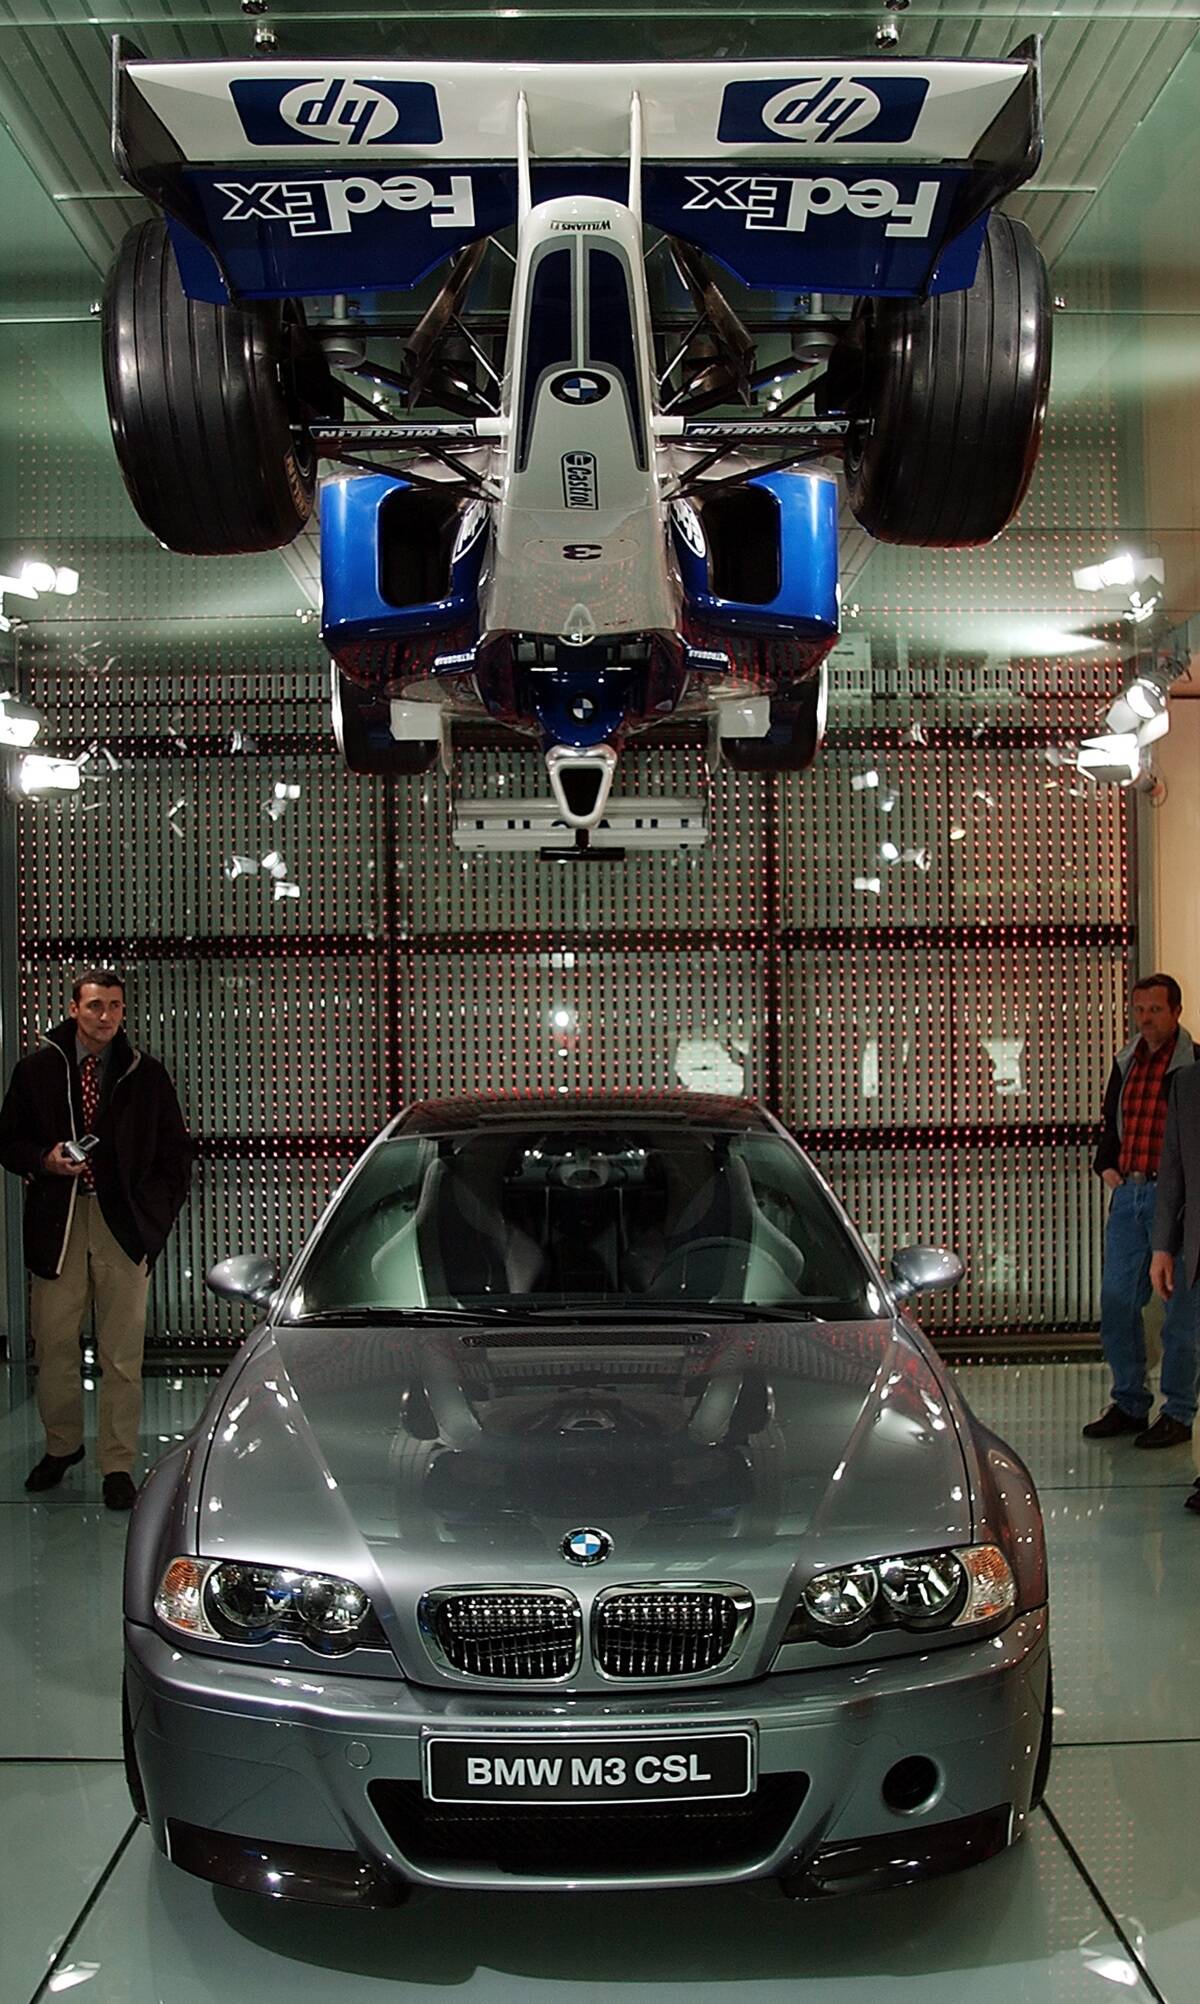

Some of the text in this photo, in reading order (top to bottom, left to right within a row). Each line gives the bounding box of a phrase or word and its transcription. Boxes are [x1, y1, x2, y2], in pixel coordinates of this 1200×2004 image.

[296, 78, 379, 145] hp
[774, 77, 866, 143] hp
[214, 175, 476, 236] FedEx
[682, 176, 940, 237] FedEx
[318, 429, 438, 438] MICHELIN
[691, 425, 812, 435] MICHELIN
[566, 466, 594, 507] Castrol
[562, 544, 602, 560] 3
[467, 1754, 712, 1786] BMW M3 CSL
